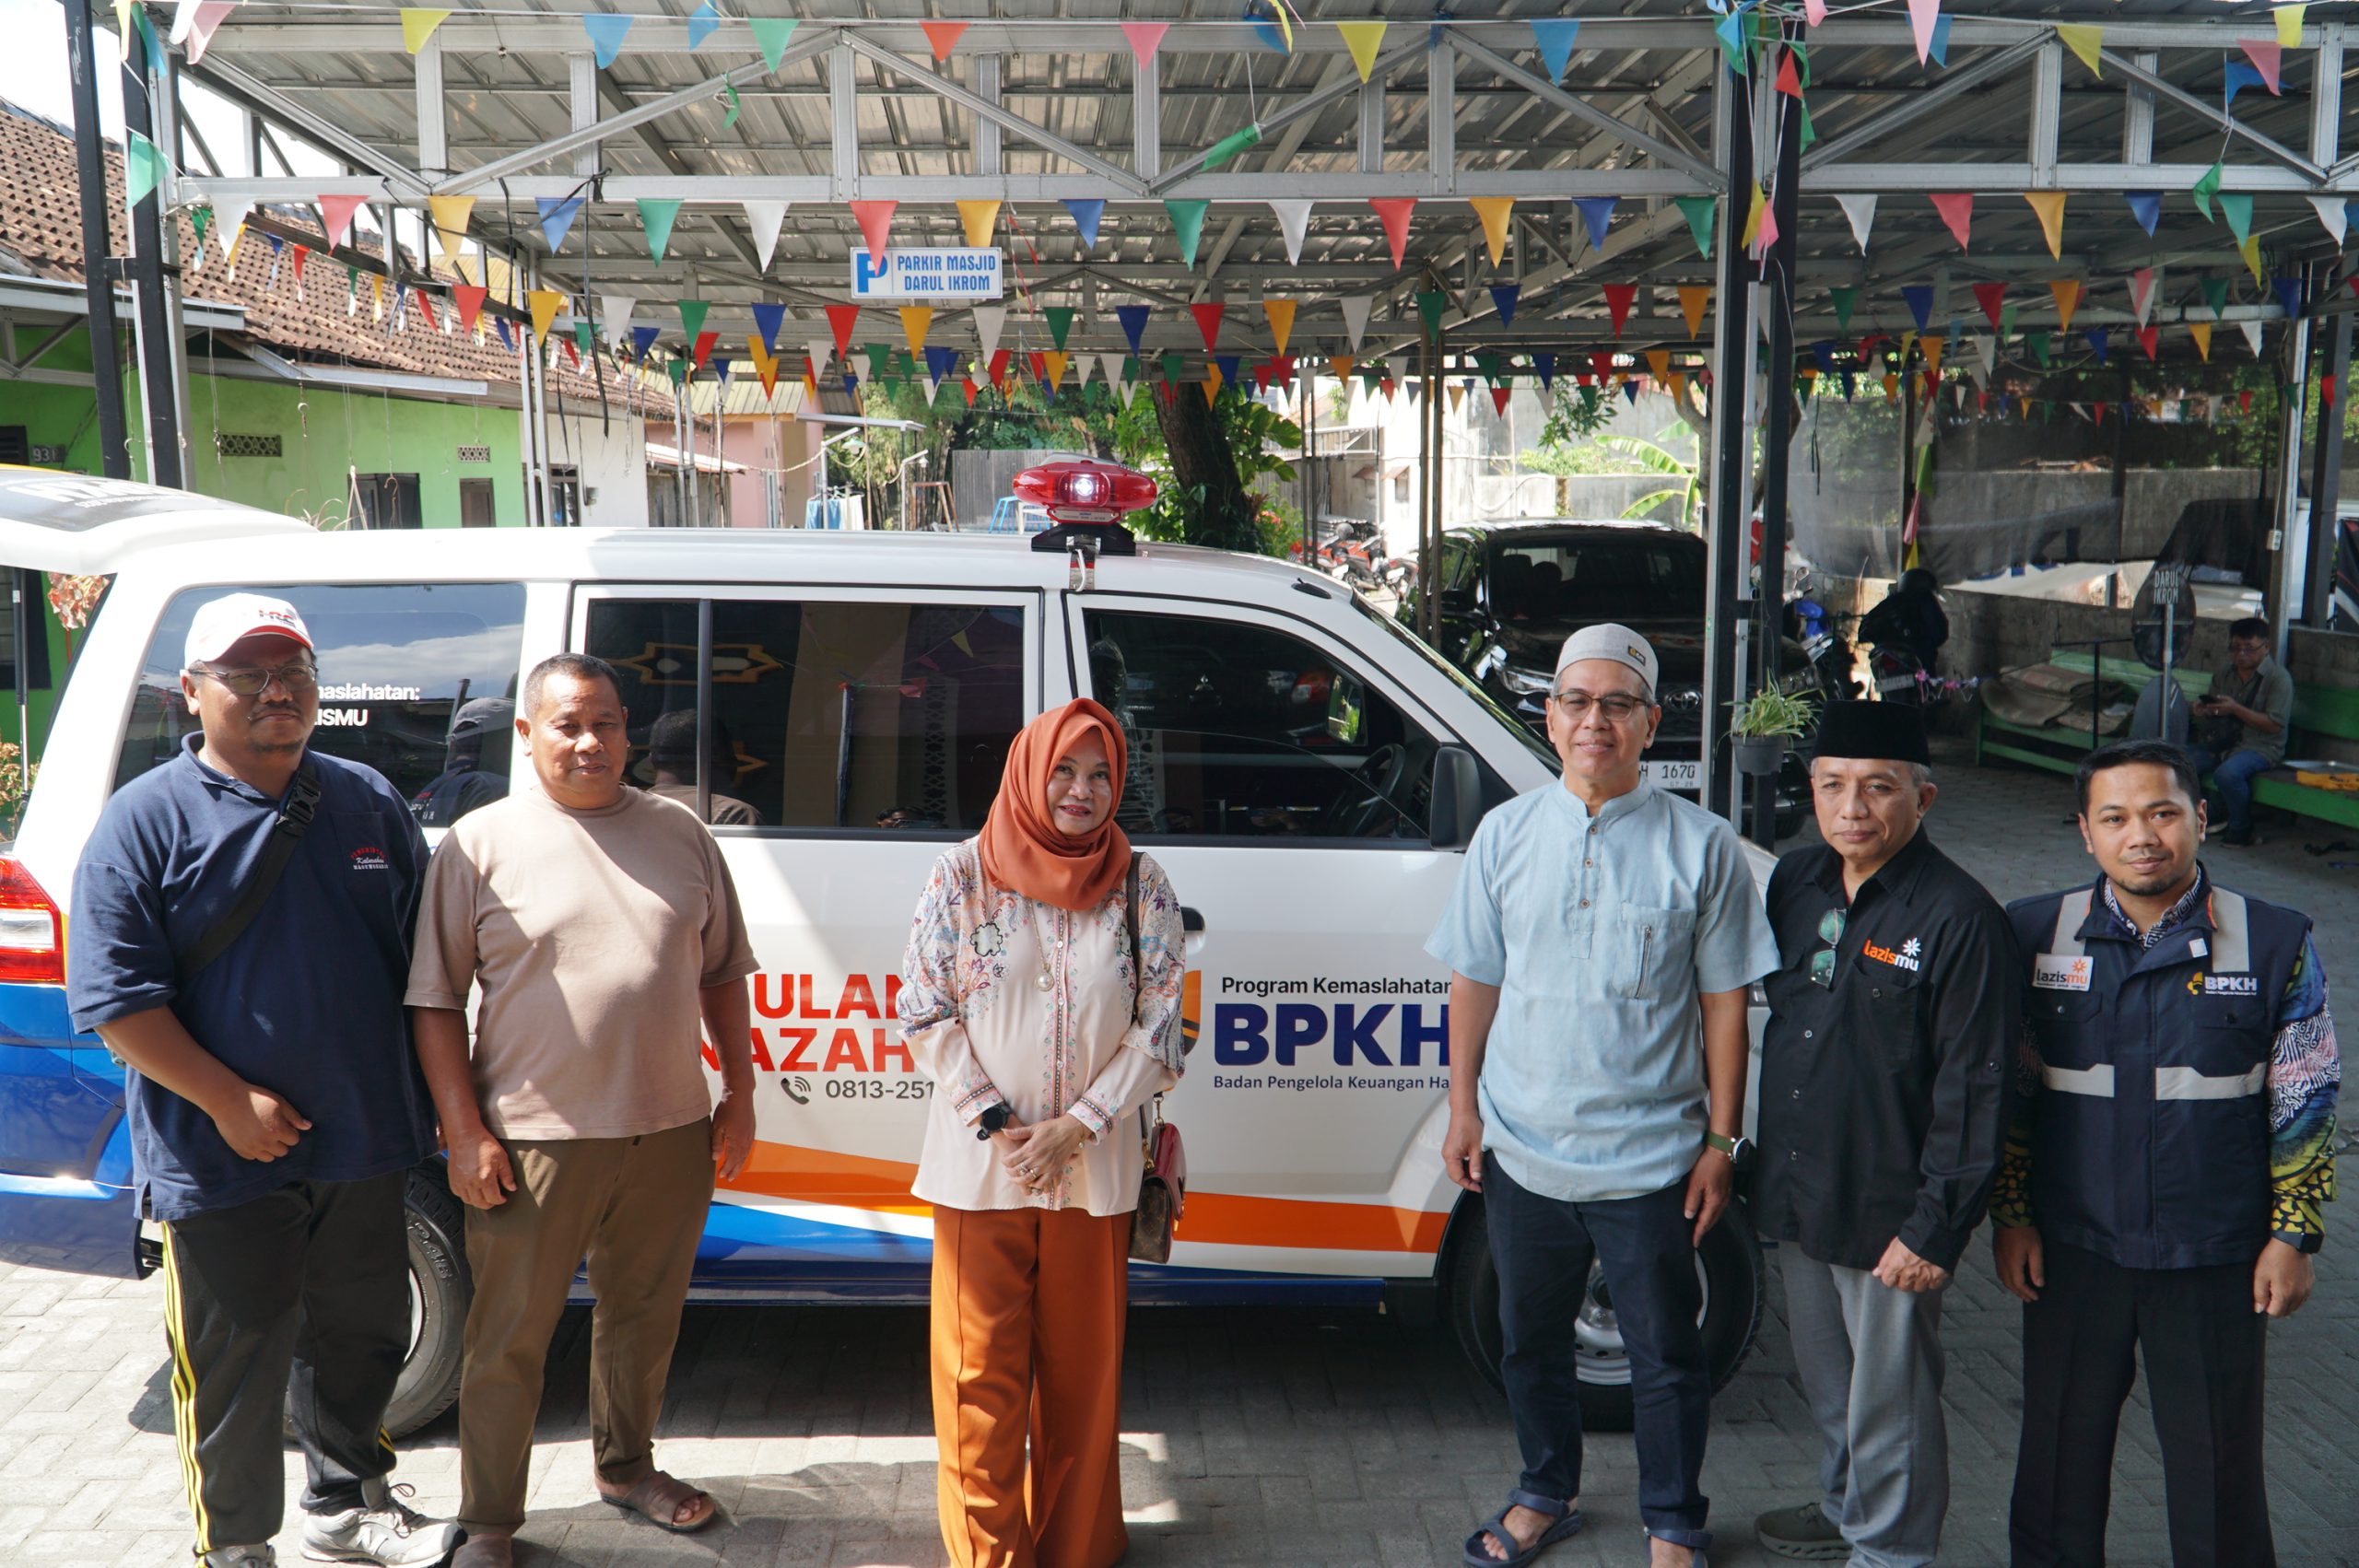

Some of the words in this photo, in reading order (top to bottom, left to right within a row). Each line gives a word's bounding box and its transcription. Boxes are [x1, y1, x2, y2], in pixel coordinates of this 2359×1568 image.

[898, 255, 942, 271] PARKIR
[946, 255, 996, 271] MASJID
[904, 275, 945, 291] DARUL
[948, 275, 990, 291] IKROM
[2154, 570, 2179, 588] DARUL
[314, 708, 369, 726] ISMU
[1661, 765, 1696, 778] 1670
[1862, 940, 1919, 971] lazismu
[2036, 968, 2088, 984] lazismu
[2204, 977, 2257, 991] BPKH
[1222, 977, 1308, 997] Program
[1215, 1003, 1450, 1066] BPKH
[1214, 1075, 1262, 1088] Badan
[1268, 1075, 1343, 1092] Pengelola
[1348, 1076, 1424, 1092] Keuangan
[1429, 1076, 1450, 1091] Ha
